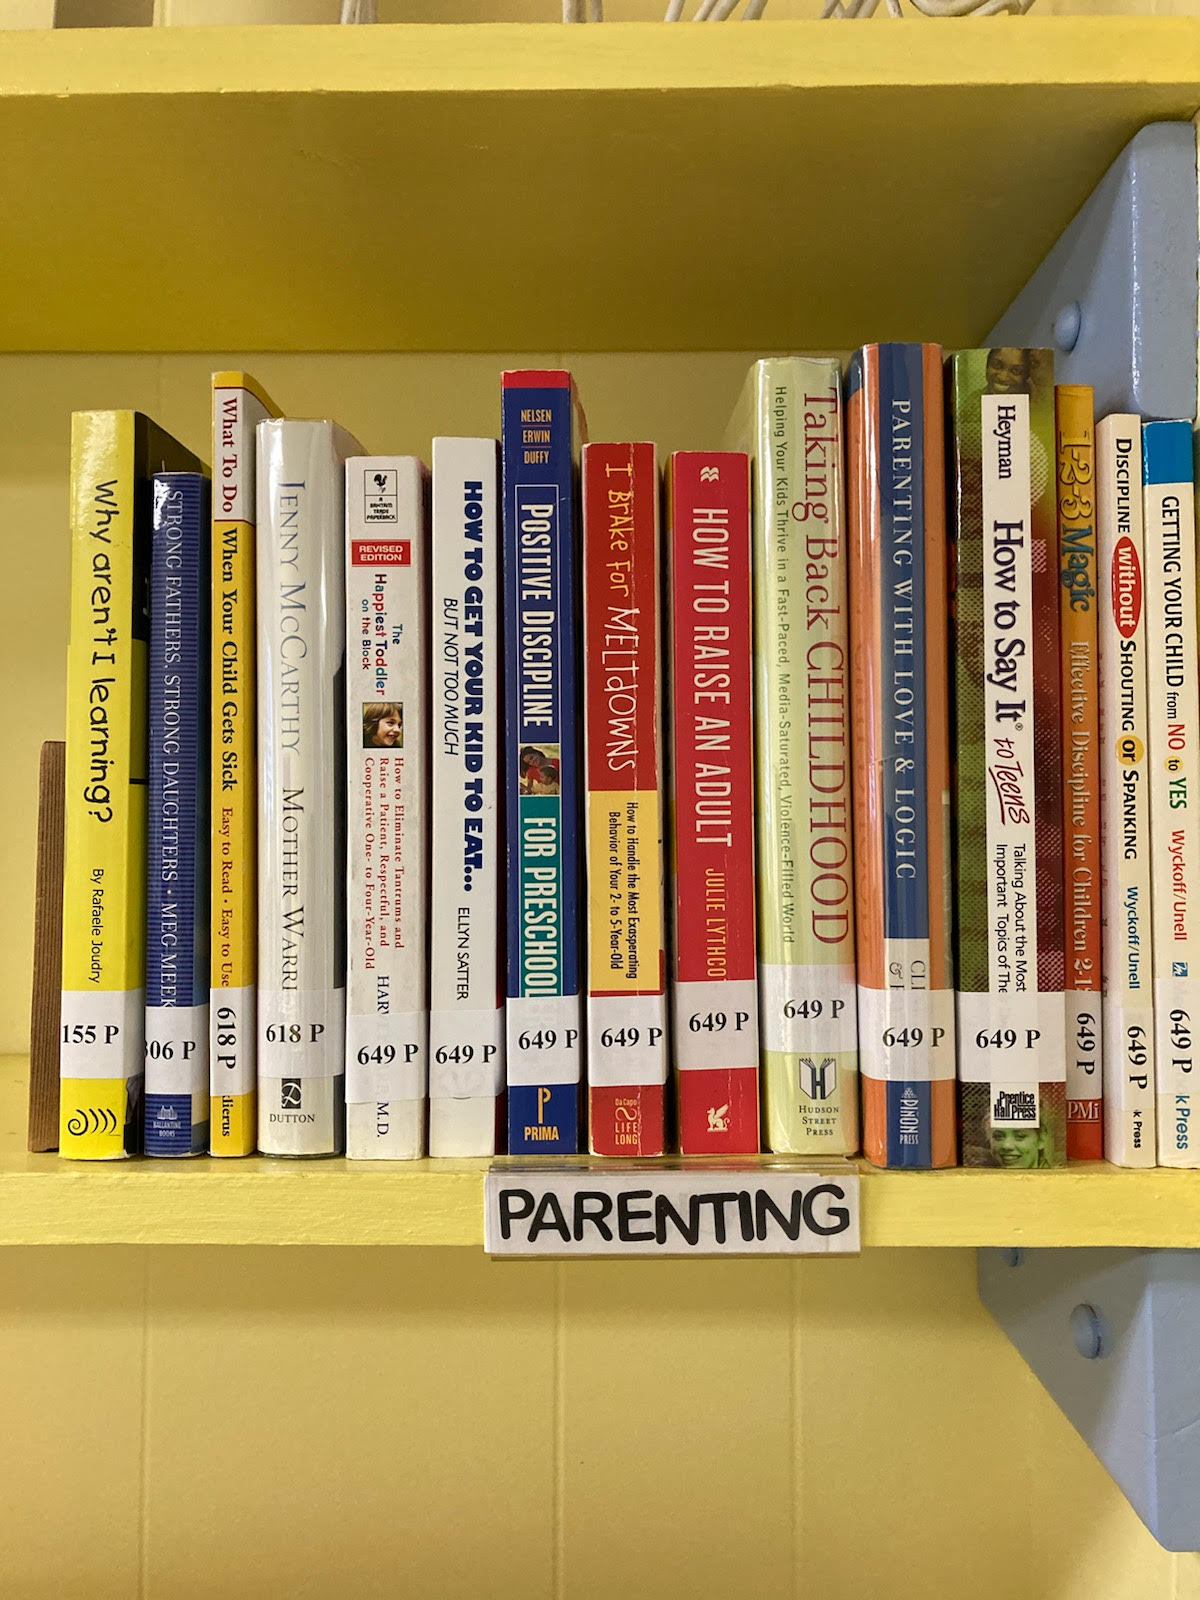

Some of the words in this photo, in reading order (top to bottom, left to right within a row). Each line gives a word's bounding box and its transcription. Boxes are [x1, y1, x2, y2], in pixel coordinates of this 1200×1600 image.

[223, 397, 238, 448] What
[521, 409, 552, 422] NELSEN
[774, 386, 787, 438] Helping
[523, 430, 550, 442] ERWIN
[524, 451, 549, 464] DUFFY
[776, 442, 788, 471] Your
[792, 387, 838, 524] Taking
[993, 406, 1016, 479] Heyman
[223, 455, 238, 478] To
[892, 400, 912, 566] PARENTING
[1116, 438, 1132, 533] DISCIPLINE
[90, 479, 119, 544] Why
[223, 484, 238, 513] Do
[464, 481, 482, 542] HOW
[776, 477, 788, 506] Kids
[165, 490, 183, 570] STRONG
[278, 481, 306, 571] JENNY
[692, 508, 729, 569] HOW
[776, 510, 788, 553] Thrive
[1162, 496, 1181, 572] GETTING
[222, 528, 238, 583] When
[464, 548, 483, 581] TO
[521, 504, 553, 600] POSITIVE
[993, 520, 1024, 592] How
[1061, 524, 1095, 612] Magic
[91, 553, 118, 646] aren't
[693, 581, 730, 612] TO
[806, 535, 840, 630] Back
[1118, 546, 1136, 628] without
[1164, 577, 1182, 629] YOUR
[222, 588, 238, 634] Your
[372, 574, 387, 637] Happiest
[444, 598, 458, 629] BUT
[464, 586, 483, 636] GET
[894, 578, 914, 656] WITH
[994, 600, 1020, 630] to
[362, 640, 371, 670] Block
[392, 624, 403, 645] The
[444, 633, 458, 666] NOT
[222, 640, 238, 694] Child
[376, 641, 387, 695] Toddler
[464, 642, 483, 716] YOUR
[522, 611, 554, 727] DISCIPLINE
[694, 626, 730, 704] RAISE
[986, 638, 1026, 692] Say
[1166, 633, 1184, 687] CHILD
[444, 670, 458, 701] TOO
[1120, 640, 1136, 732] SHOUTING
[1167, 692, 1179, 720] from
[164, 675, 181, 755] STRONG
[222, 702, 238, 745] Gets
[894, 671, 914, 744] LOVE
[84, 679, 115, 823] learning?
[444, 704, 458, 756] MUCH
[465, 722, 483, 772] KID
[694, 716, 730, 750] AN
[1168, 724, 1186, 750] NO
[222, 752, 238, 791] Sick
[363, 757, 374, 829] Cooperative
[807, 642, 848, 944] CHILDHOOD
[1067, 731, 1092, 826] Discipline
[1169, 776, 1186, 810] YES
[464, 778, 483, 812] TO
[695, 762, 732, 847] ADULT
[1123, 770, 1139, 860] SPANKING
[161, 763, 180, 882] DAUGHTERS
[218, 808, 233, 837] Easy
[282, 787, 304, 896] MOTHER
[379, 804, 389, 849] Patient,
[395, 805, 404, 862] Eliminate
[524, 818, 556, 858] FOR
[610, 812, 620, 854] Behavior
[895, 788, 916, 878] LOGIC
[627, 837, 640, 870] Handle
[1012, 844, 1026, 888] Talking
[90, 868, 104, 884] By
[222, 861, 233, 894] Read
[378, 855, 389, 920] Respectful,
[395, 867, 404, 922] Tantrums
[706, 868, 725, 911] JULIE
[994, 844, 1008, 907] Important
[1168, 830, 1188, 941] Wyckoff/Unell
[91, 889, 104, 936] Rafaele
[218, 909, 233, 940] Easy
[458, 907, 470, 949] ELLYN
[782, 903, 794, 943] World
[1015, 892, 1027, 932] About
[1072, 867, 1092, 951] Children
[524, 867, 557, 998] PRESCHOOL
[626, 918, 640, 979] Exasperating
[995, 914, 1009, 952] Topics
[1124, 886, 1140, 989] Wyckoff/Unell
[88, 941, 103, 984] Joudry
[457, 952, 469, 1000] SATTER
[1016, 960, 1027, 992] Most
[217, 1007, 237, 1046] 618
[690, 1012, 726, 1032] 649
[734, 1012, 749, 1030] P
[784, 1000, 822, 1019] 649
[832, 1000, 845, 1018] P
[1170, 1010, 1192, 1050] 649
[62, 1025, 96, 1044] 155
[104, 1025, 119, 1044] P
[266, 1024, 300, 1043] 618
[310, 1024, 325, 1042] P
[518, 1030, 556, 1050] 649
[565, 1030, 578, 1048] P
[602, 1028, 639, 1048] 649
[648, 1028, 662, 1046] P
[882, 1028, 923, 1048] 649
[932, 1028, 945, 1047] P
[976, 1029, 1016, 1048] 649
[1025, 1030, 1040, 1048] P
[1076, 1013, 1096, 1051] 649
[1128, 1026, 1147, 1066] 649
[358, 1045, 395, 1064] 649
[404, 1044, 418, 1062] P
[436, 1045, 474, 1064] 649
[482, 1045, 496, 1063] P
[269, 1113, 315, 1123] DUTTON
[377, 1102, 389, 1137] M.D.
[799, 1106, 839, 1114] HUDSON
[994, 1103, 1010, 1118] Hall
[1012, 1105, 1036, 1119] Press
[999, 1091, 1034, 1105] Prentice
[524, 1126, 559, 1140] PRIMA
[615, 1122, 638, 1132] LIFE
[615, 1134, 638, 1145] LONG
[802, 1116, 837, 1124] STREET
[806, 1128, 834, 1136] PRESS
[900, 1134, 918, 1144] PRESS
[1133, 1122, 1142, 1148] Press
[1176, 1108, 1190, 1150] Press
[500, 1184, 850, 1246] PARENTING
